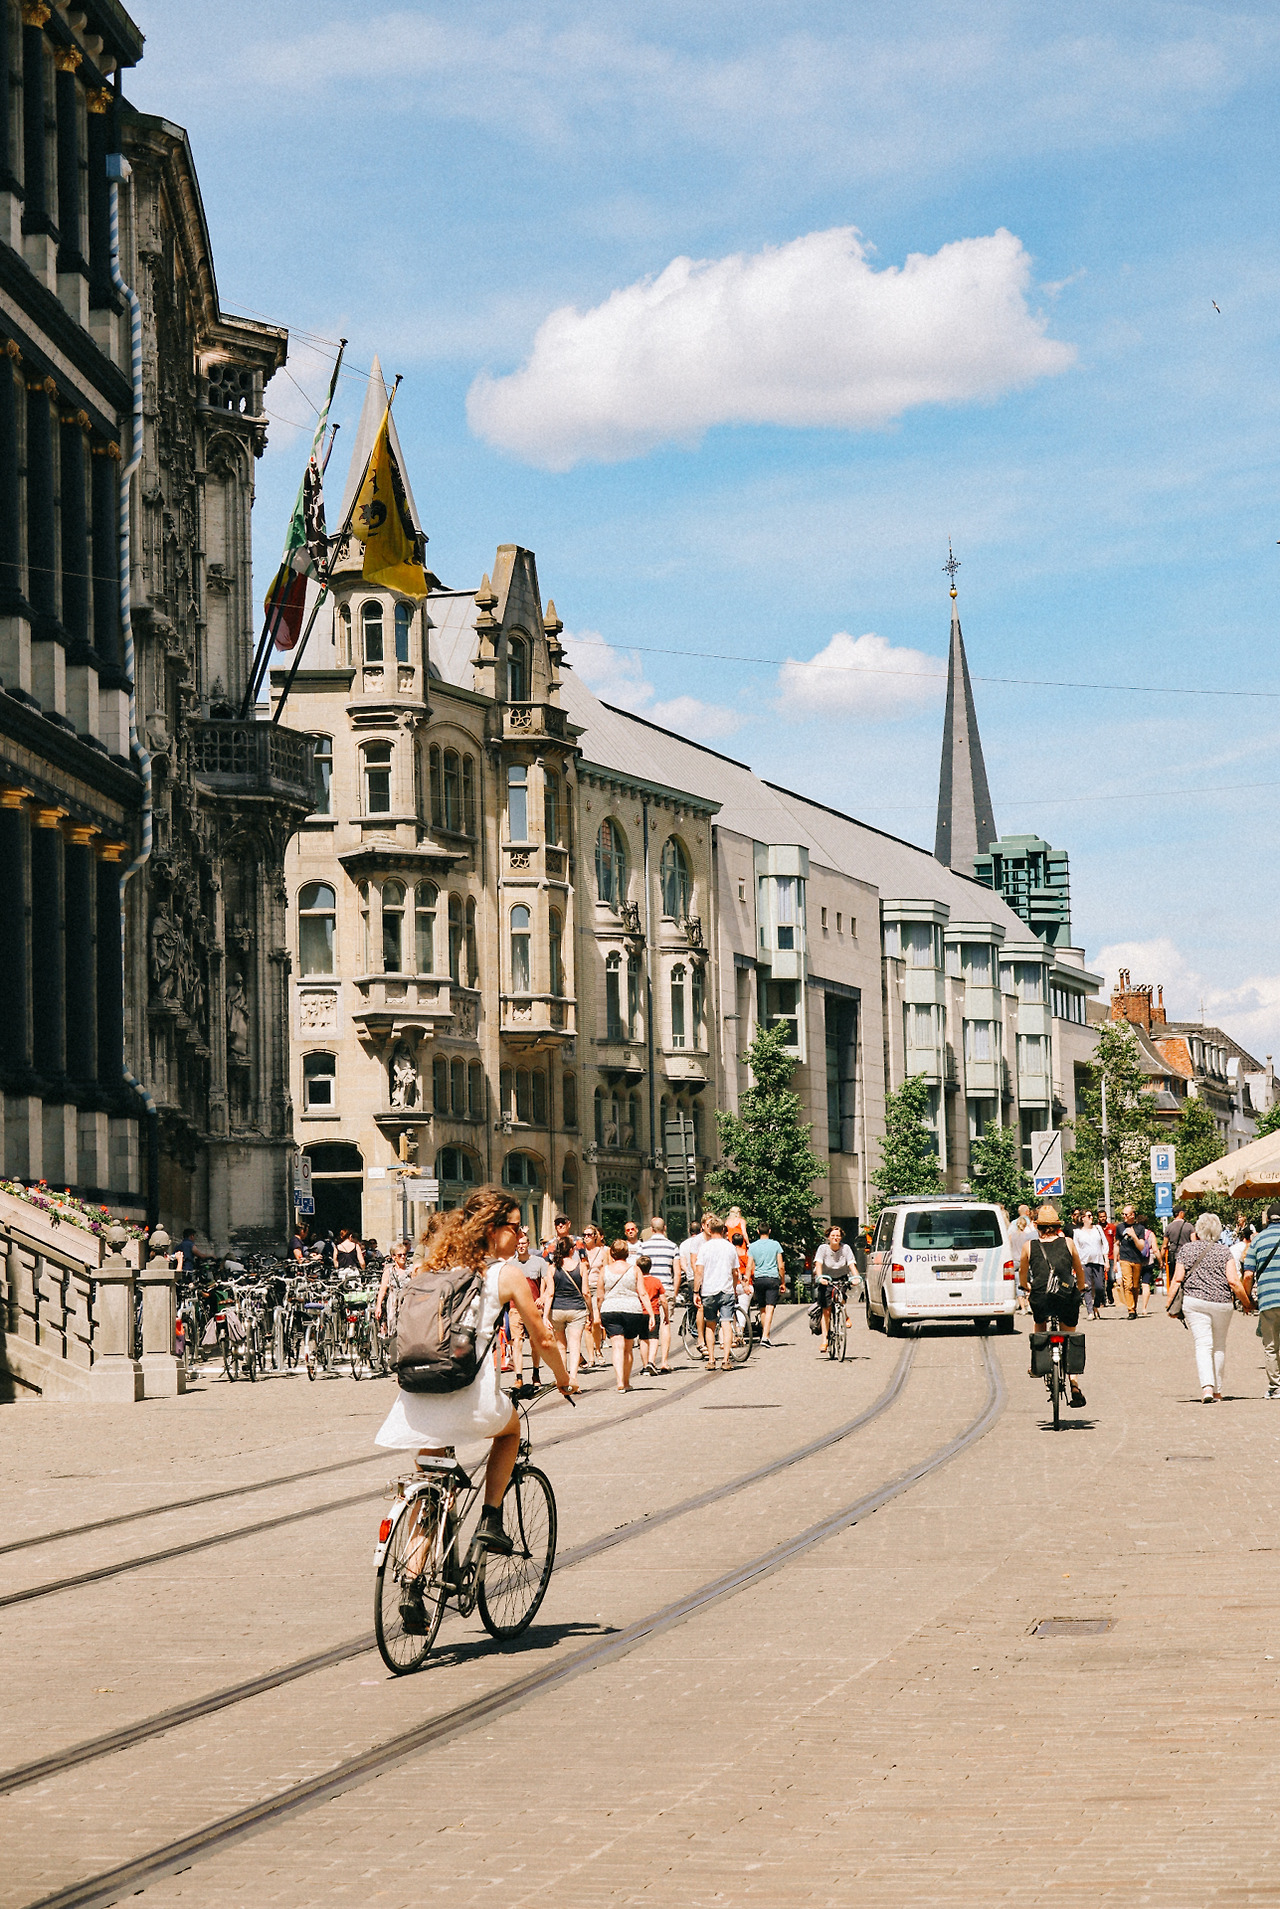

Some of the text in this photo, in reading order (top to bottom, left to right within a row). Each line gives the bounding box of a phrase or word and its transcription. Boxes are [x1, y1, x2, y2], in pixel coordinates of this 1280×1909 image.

[1159, 1155, 1166, 1165] P
[1157, 1187, 1169, 1205] P
[916, 1254, 946, 1262] Politie
